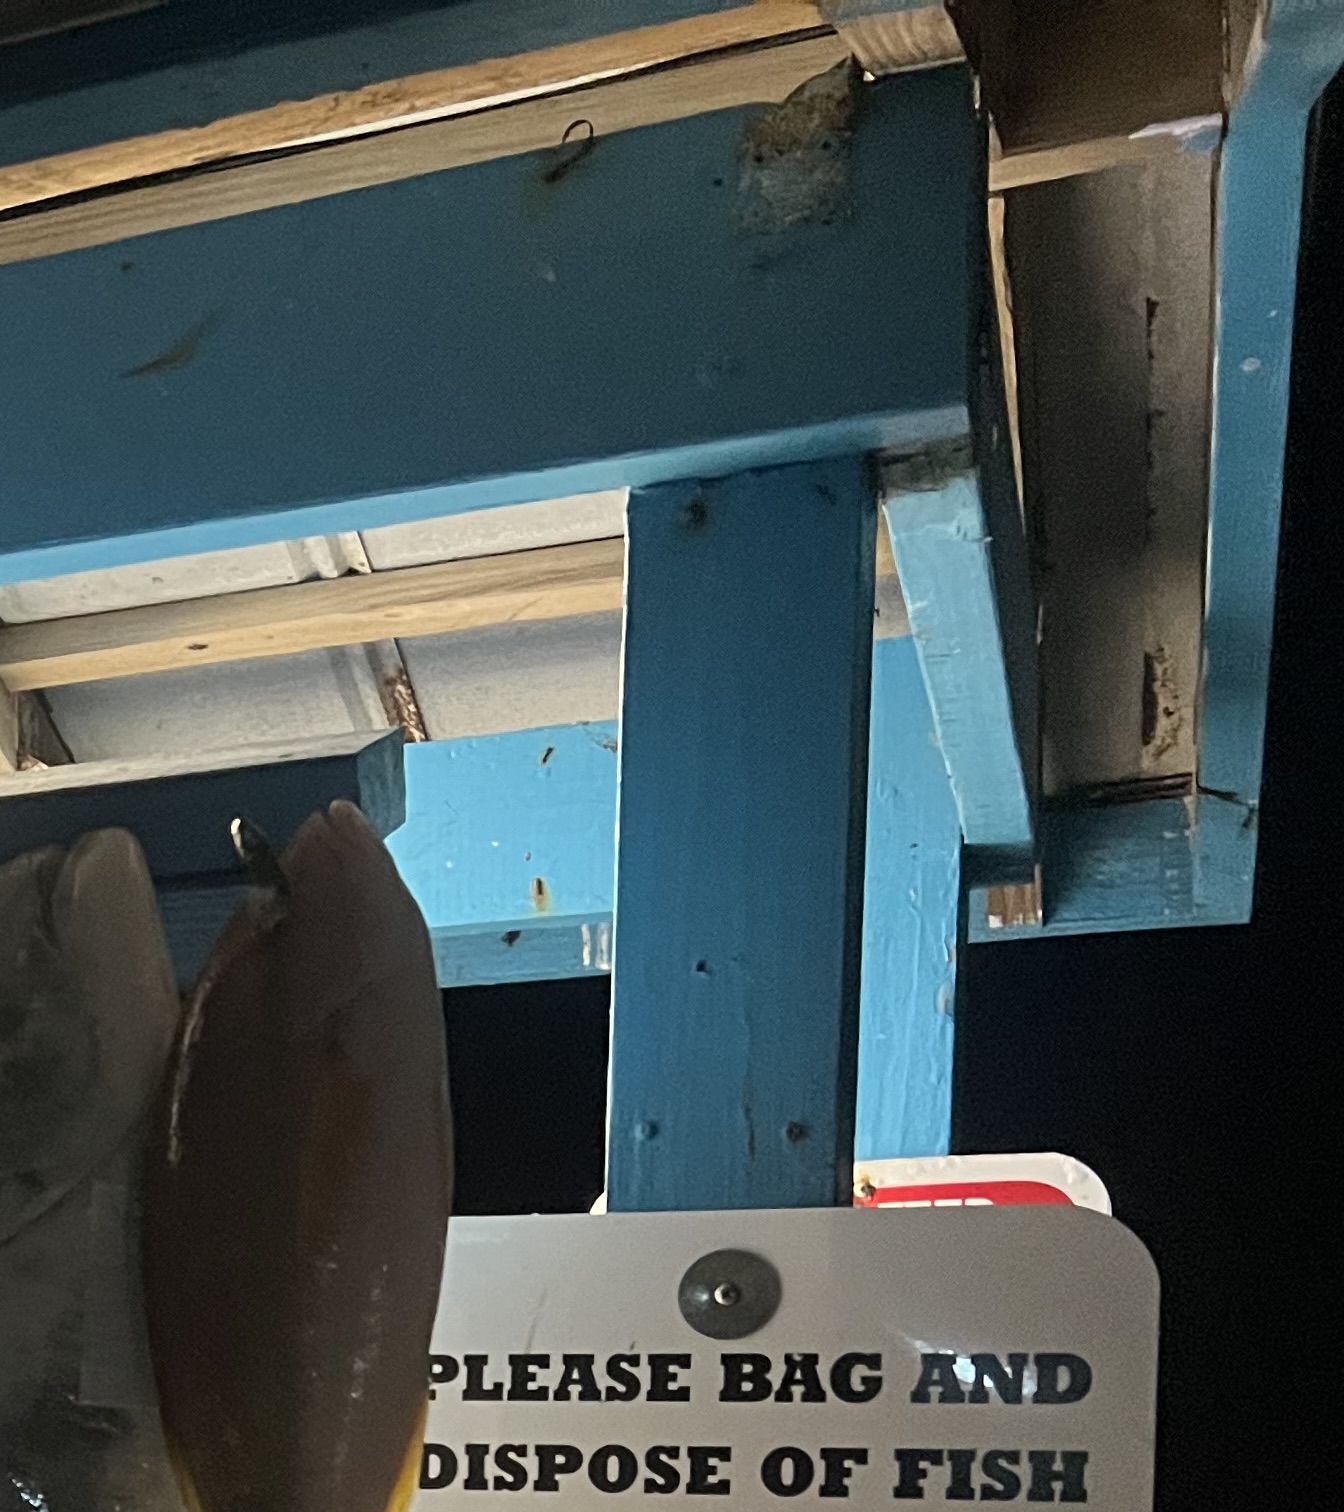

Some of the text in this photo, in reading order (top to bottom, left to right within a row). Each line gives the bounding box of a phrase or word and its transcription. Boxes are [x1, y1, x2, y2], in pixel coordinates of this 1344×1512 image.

[429, 1352, 1092, 1404] PLEASE BAG AND
[419, 1444, 1089, 1504] DISPOSE OF FISH
